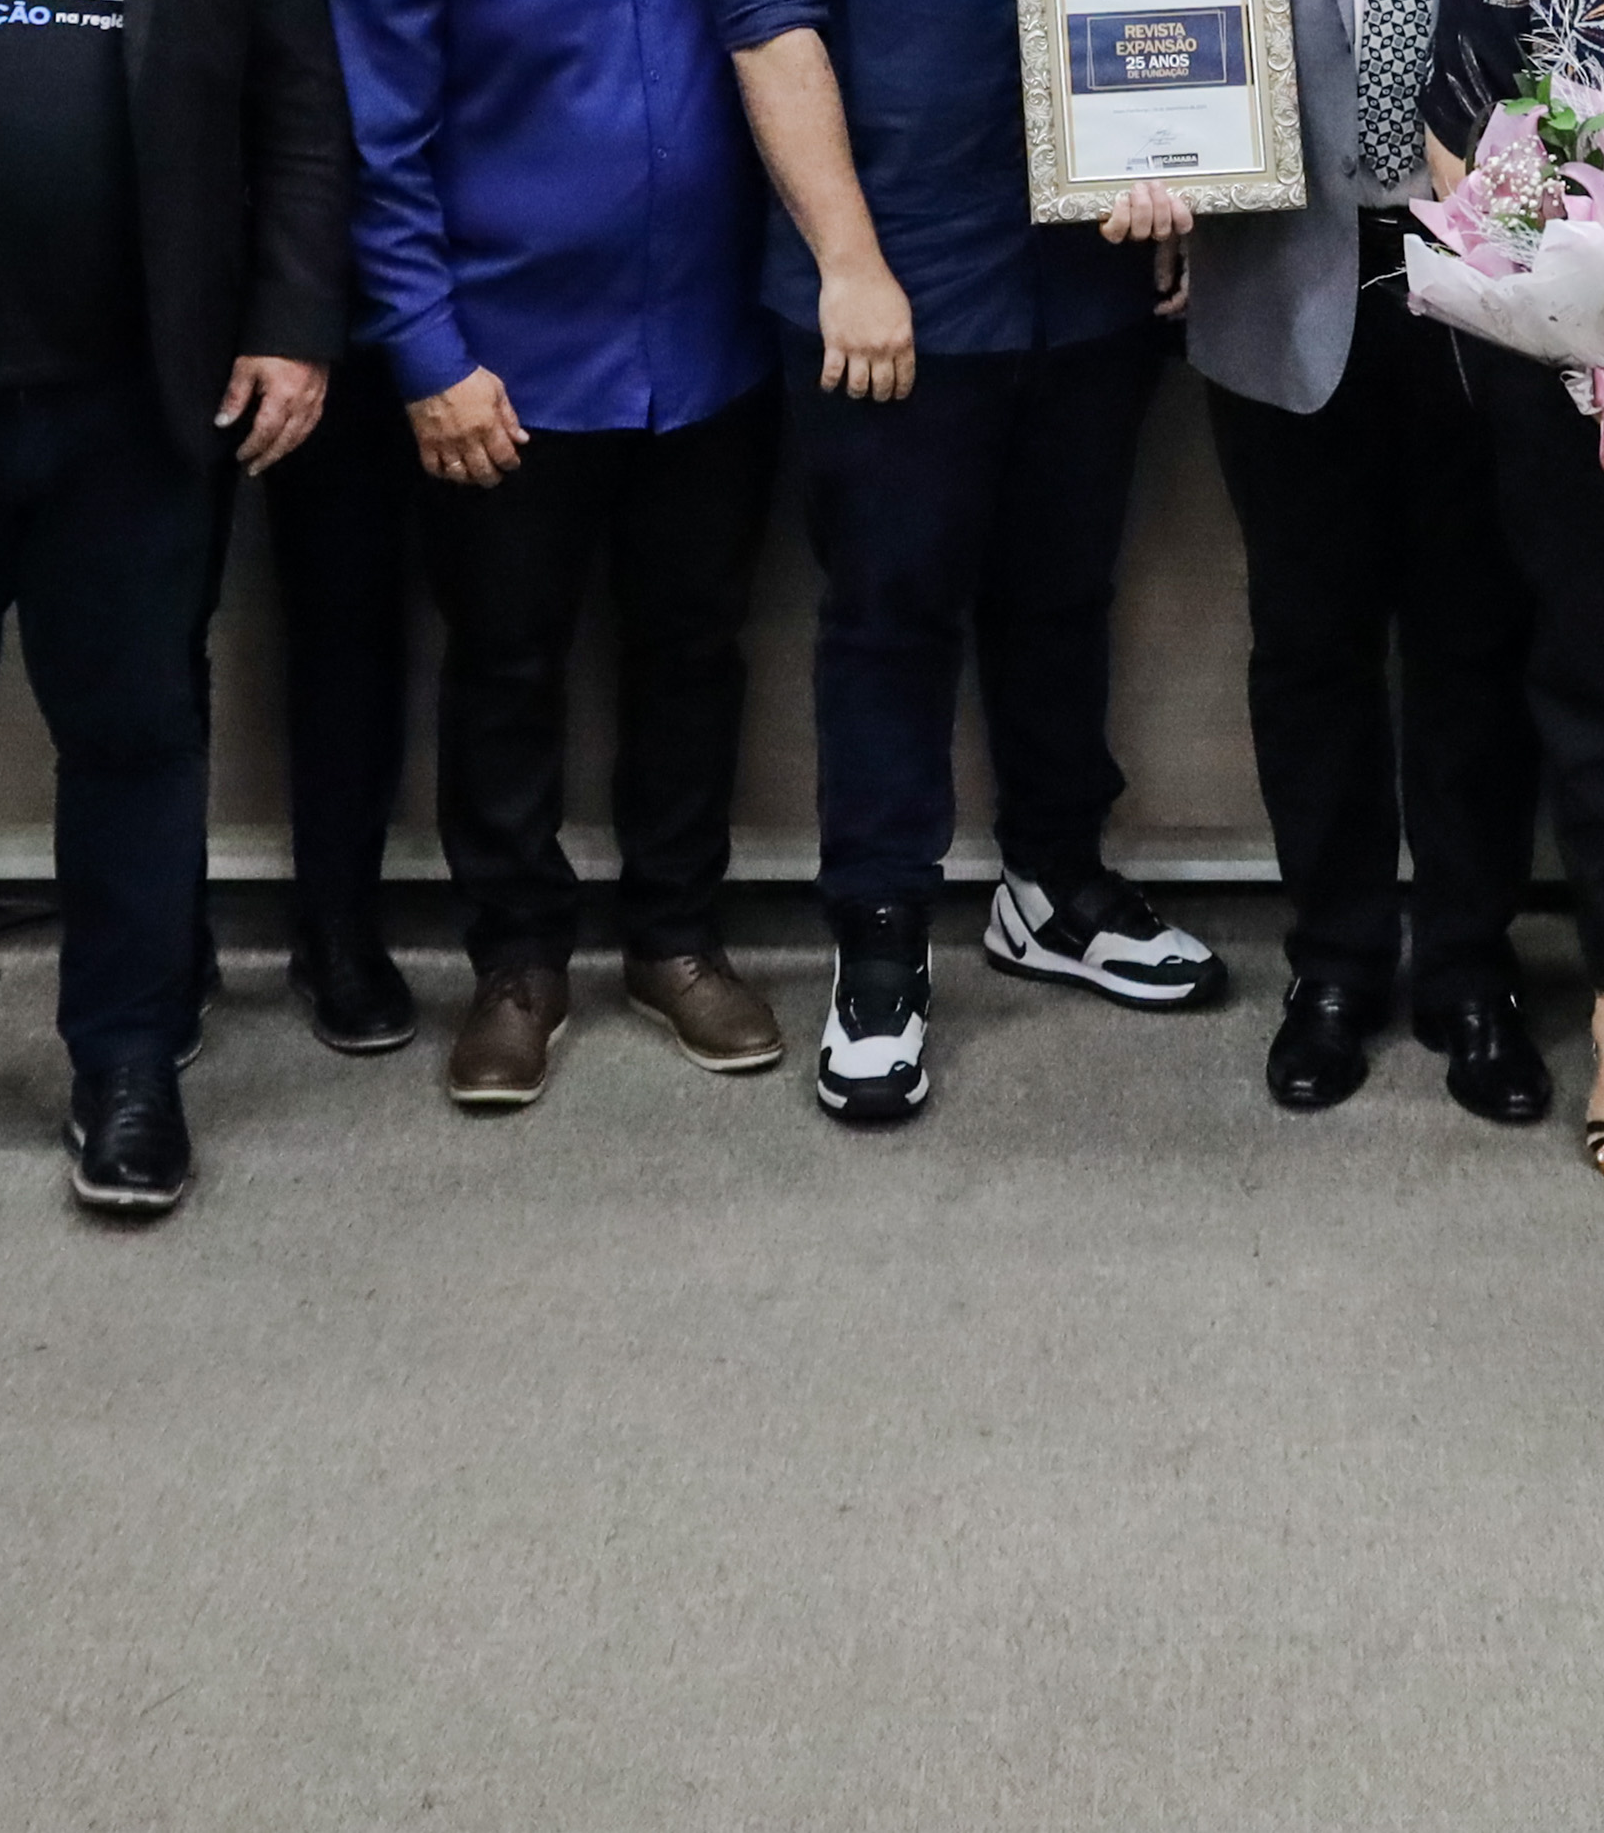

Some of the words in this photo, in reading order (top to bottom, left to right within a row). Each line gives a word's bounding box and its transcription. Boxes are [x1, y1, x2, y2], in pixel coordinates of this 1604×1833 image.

[55, 12, 80, 24] na
[1124, 22, 1187, 39] REVISTA
[1116, 36, 1198, 56] EXPANSÃO
[1125, 56, 1146, 70] 25
[1148, 53, 1191, 69] ANOS
[1127, 69, 1140, 79] DE
